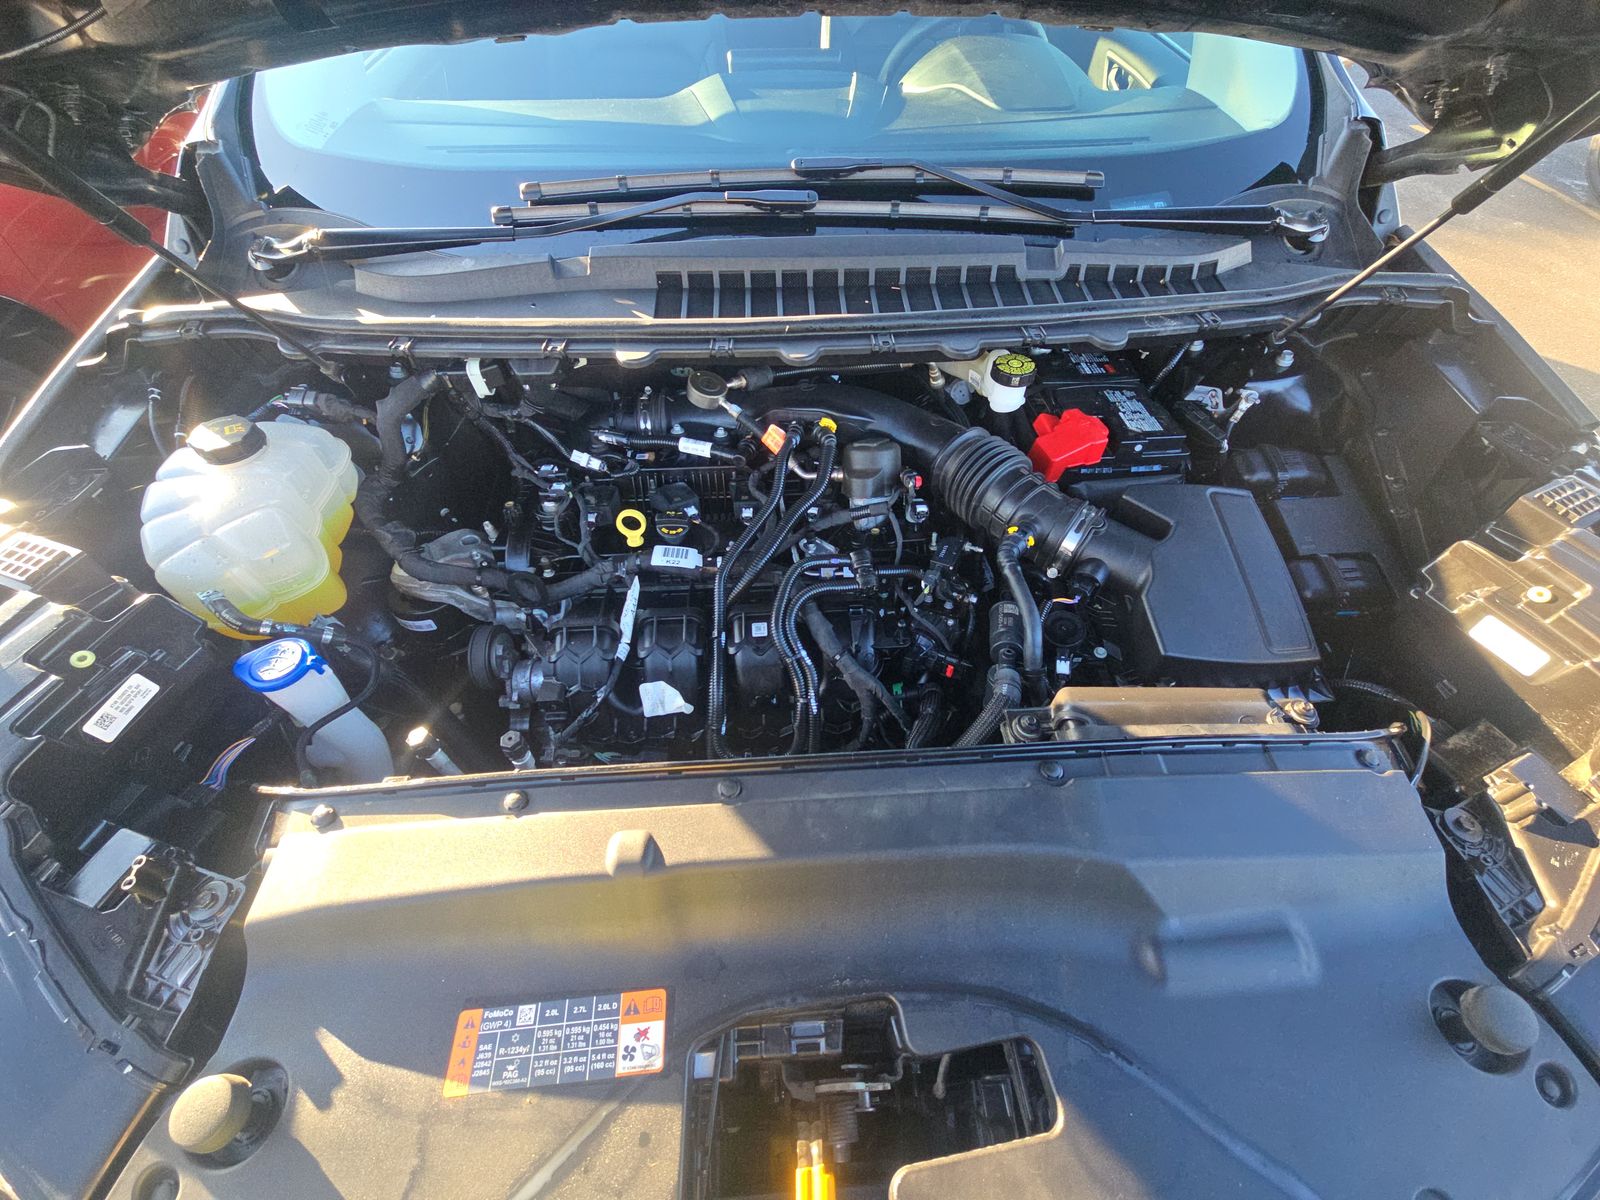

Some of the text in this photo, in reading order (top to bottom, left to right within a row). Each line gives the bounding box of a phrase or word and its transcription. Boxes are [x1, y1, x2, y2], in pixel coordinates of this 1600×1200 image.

[484, 1009, 513, 1018] FoMoCo
[573, 1006, 587, 1014] 2.7L
[480, 1020, 511, 1031] (GWP 4)
[594, 1022, 618, 1031] 0.454 kg
[537, 1029, 562, 1038] 0.595 kg
[566, 1026, 590, 1034] 0.595 kg
[479, 1043, 492, 1051] SAE
[499, 1045, 530, 1055] R-1234yf
[563, 1057, 573, 1065] 3.2
[592, 1053, 601, 1061] 5.4
[534, 1060, 543, 1068] 3.2
[606, 1061, 615, 1069] cc)
[535, 1068, 555, 1077] (95 cc)
[564, 1064, 585, 1074] (95 cc)
[502, 1071, 518, 1079] PAG
